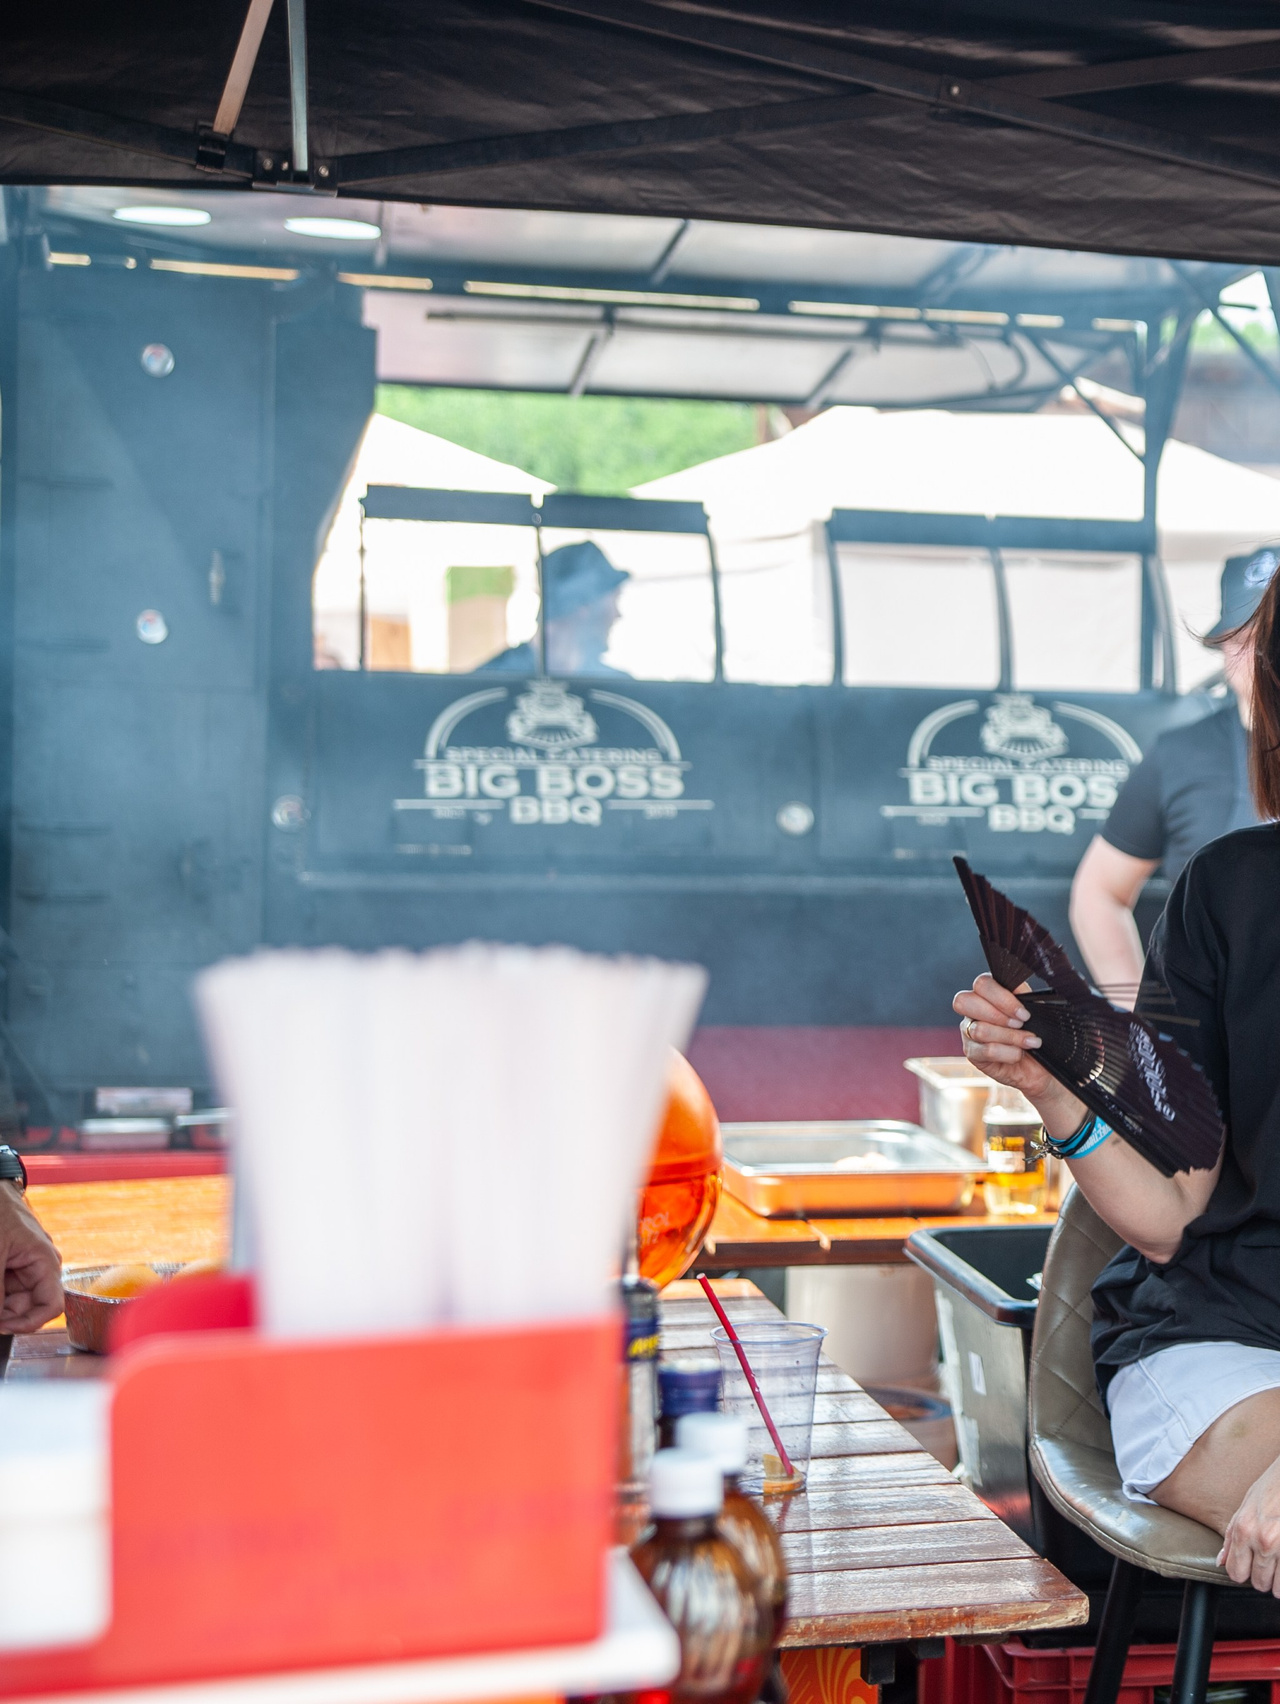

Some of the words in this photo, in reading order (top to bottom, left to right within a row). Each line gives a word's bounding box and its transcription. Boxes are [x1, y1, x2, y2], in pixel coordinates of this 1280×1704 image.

[425, 763, 520, 799] BIG
[537, 764, 685, 799] BOSS
[909, 772, 999, 806] BIG
[1012, 773, 1119, 808] BOS
[510, 796, 602, 826] BBQ
[988, 804, 1076, 834] BBQ
